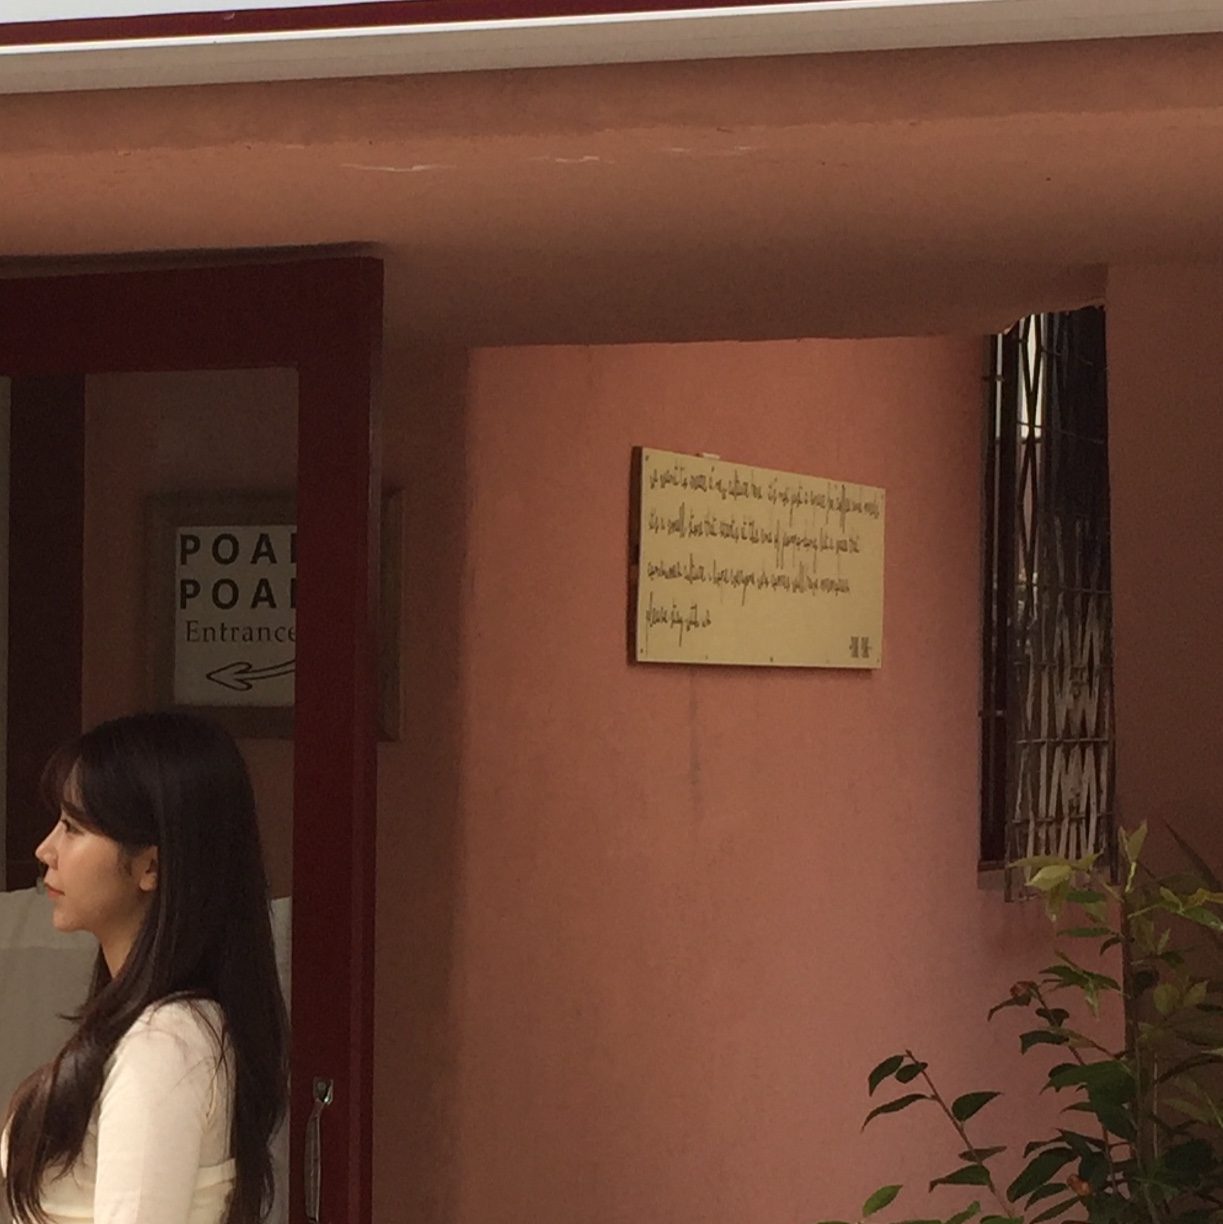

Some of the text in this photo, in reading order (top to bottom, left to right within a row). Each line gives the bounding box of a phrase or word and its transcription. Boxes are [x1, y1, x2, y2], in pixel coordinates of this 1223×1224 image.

[180, 533, 296, 565] POA
[180, 578, 296, 609] POA
[186, 620, 296, 642] Entrance
